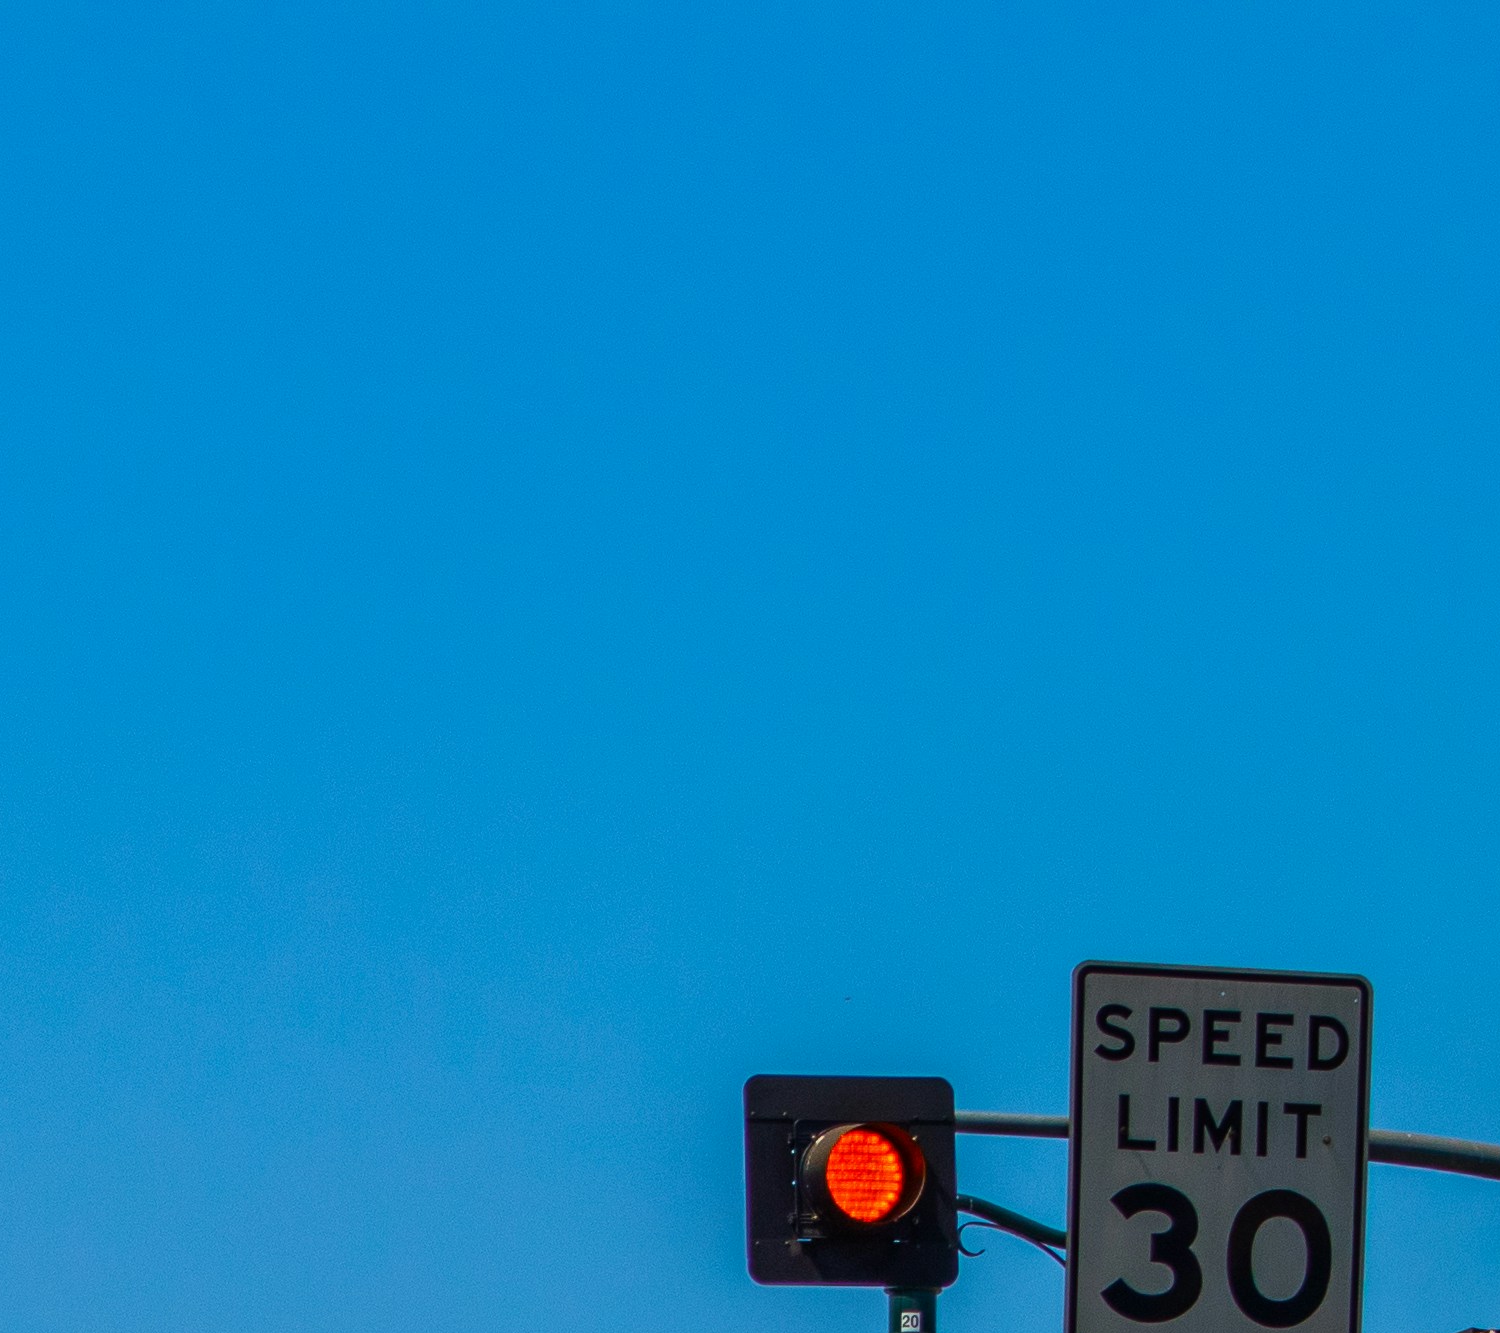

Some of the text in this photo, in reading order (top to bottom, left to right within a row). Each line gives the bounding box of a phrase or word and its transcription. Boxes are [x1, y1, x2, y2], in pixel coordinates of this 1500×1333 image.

[1094, 1003, 1350, 1072] SPEED
[1117, 1093, 1322, 1159] LIMIT
[1100, 1182, 1332, 1329] 30
[902, 1314, 919, 1328] 20
